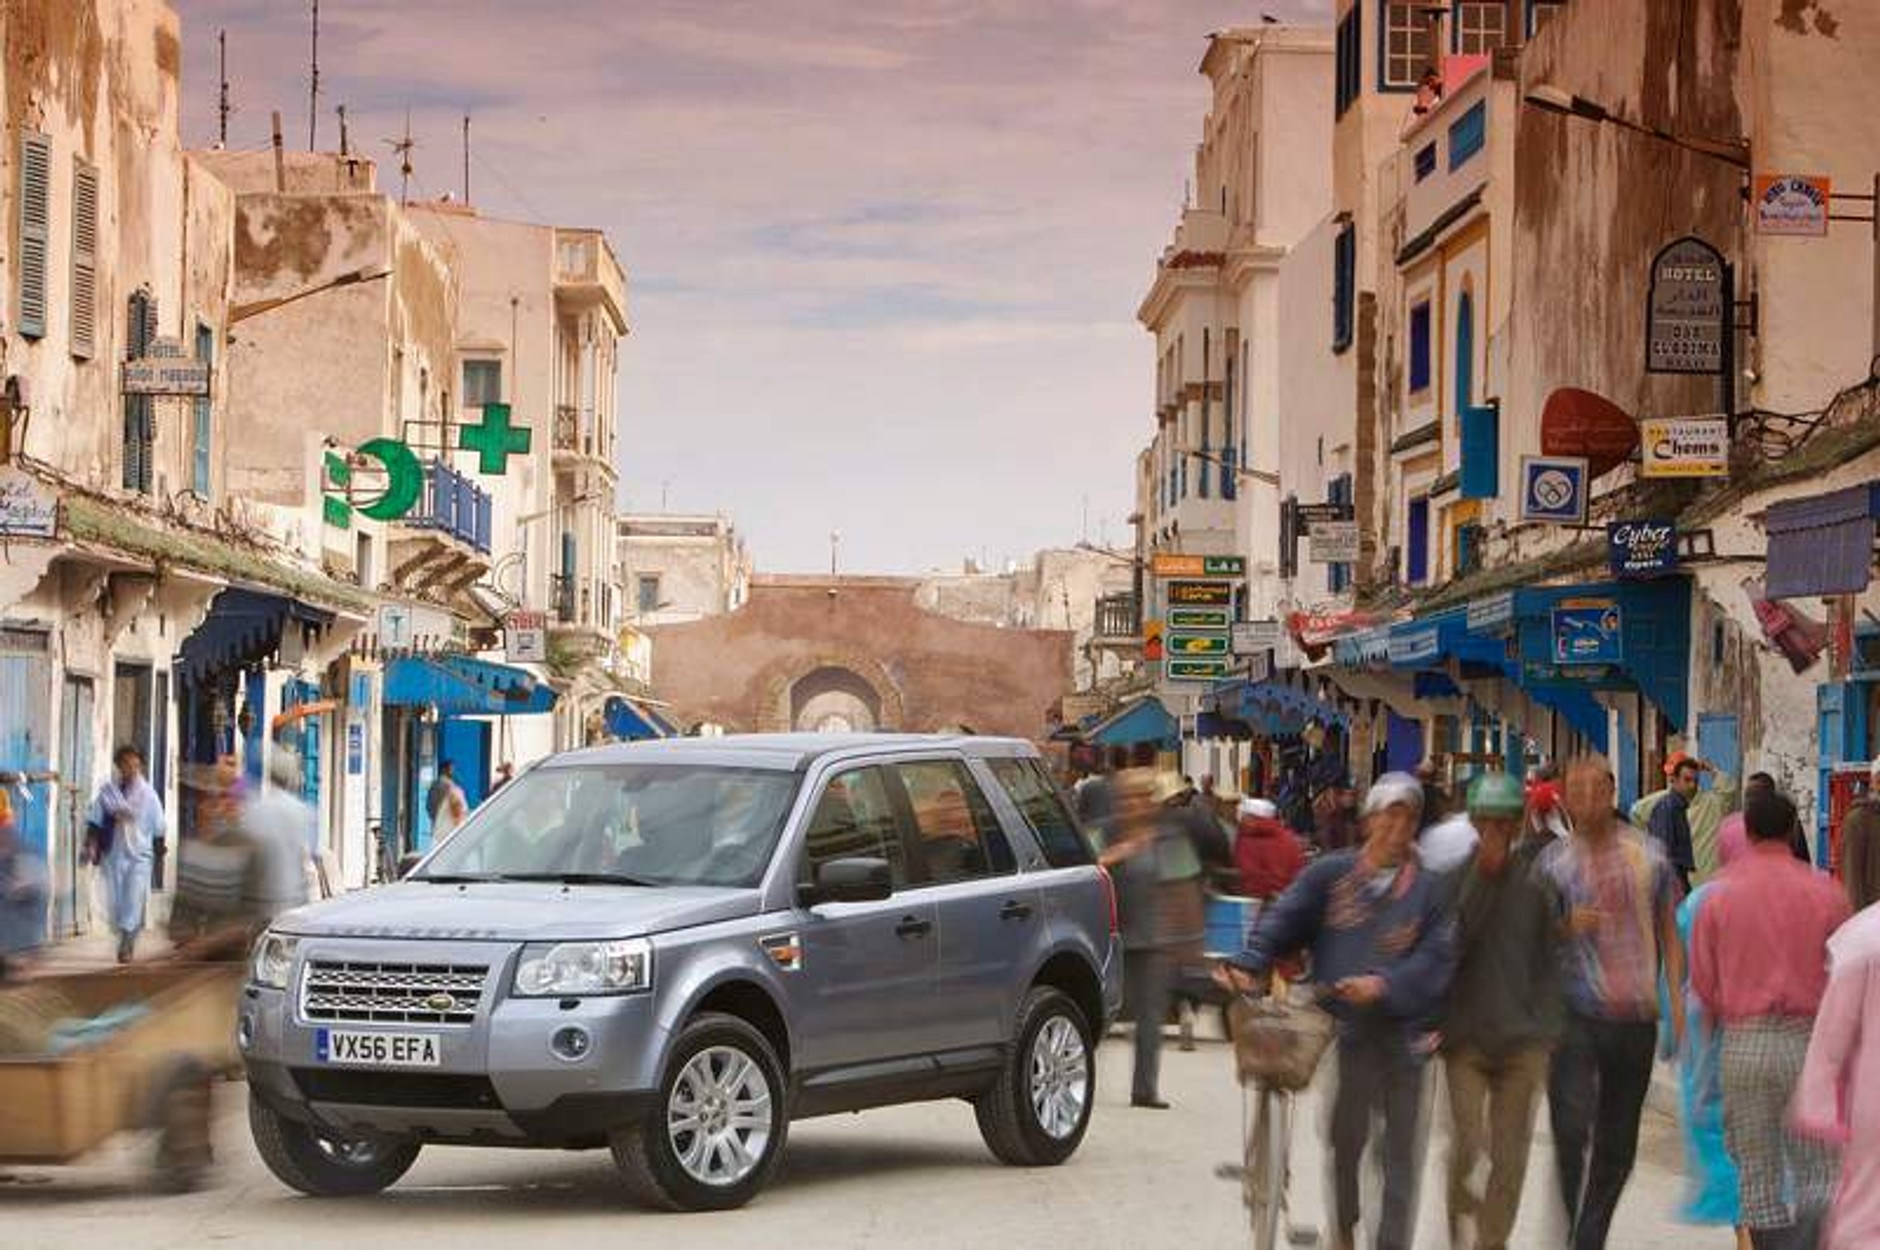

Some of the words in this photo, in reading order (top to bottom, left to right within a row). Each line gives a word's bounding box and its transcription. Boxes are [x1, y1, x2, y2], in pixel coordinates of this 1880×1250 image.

[1661, 267, 1715, 281] HOTEL
[1653, 438, 1721, 460] Chems
[1613, 524, 1671, 550] Cyber
[333, 1034, 387, 1060] VX56
[392, 1037, 436, 1062] EFA
